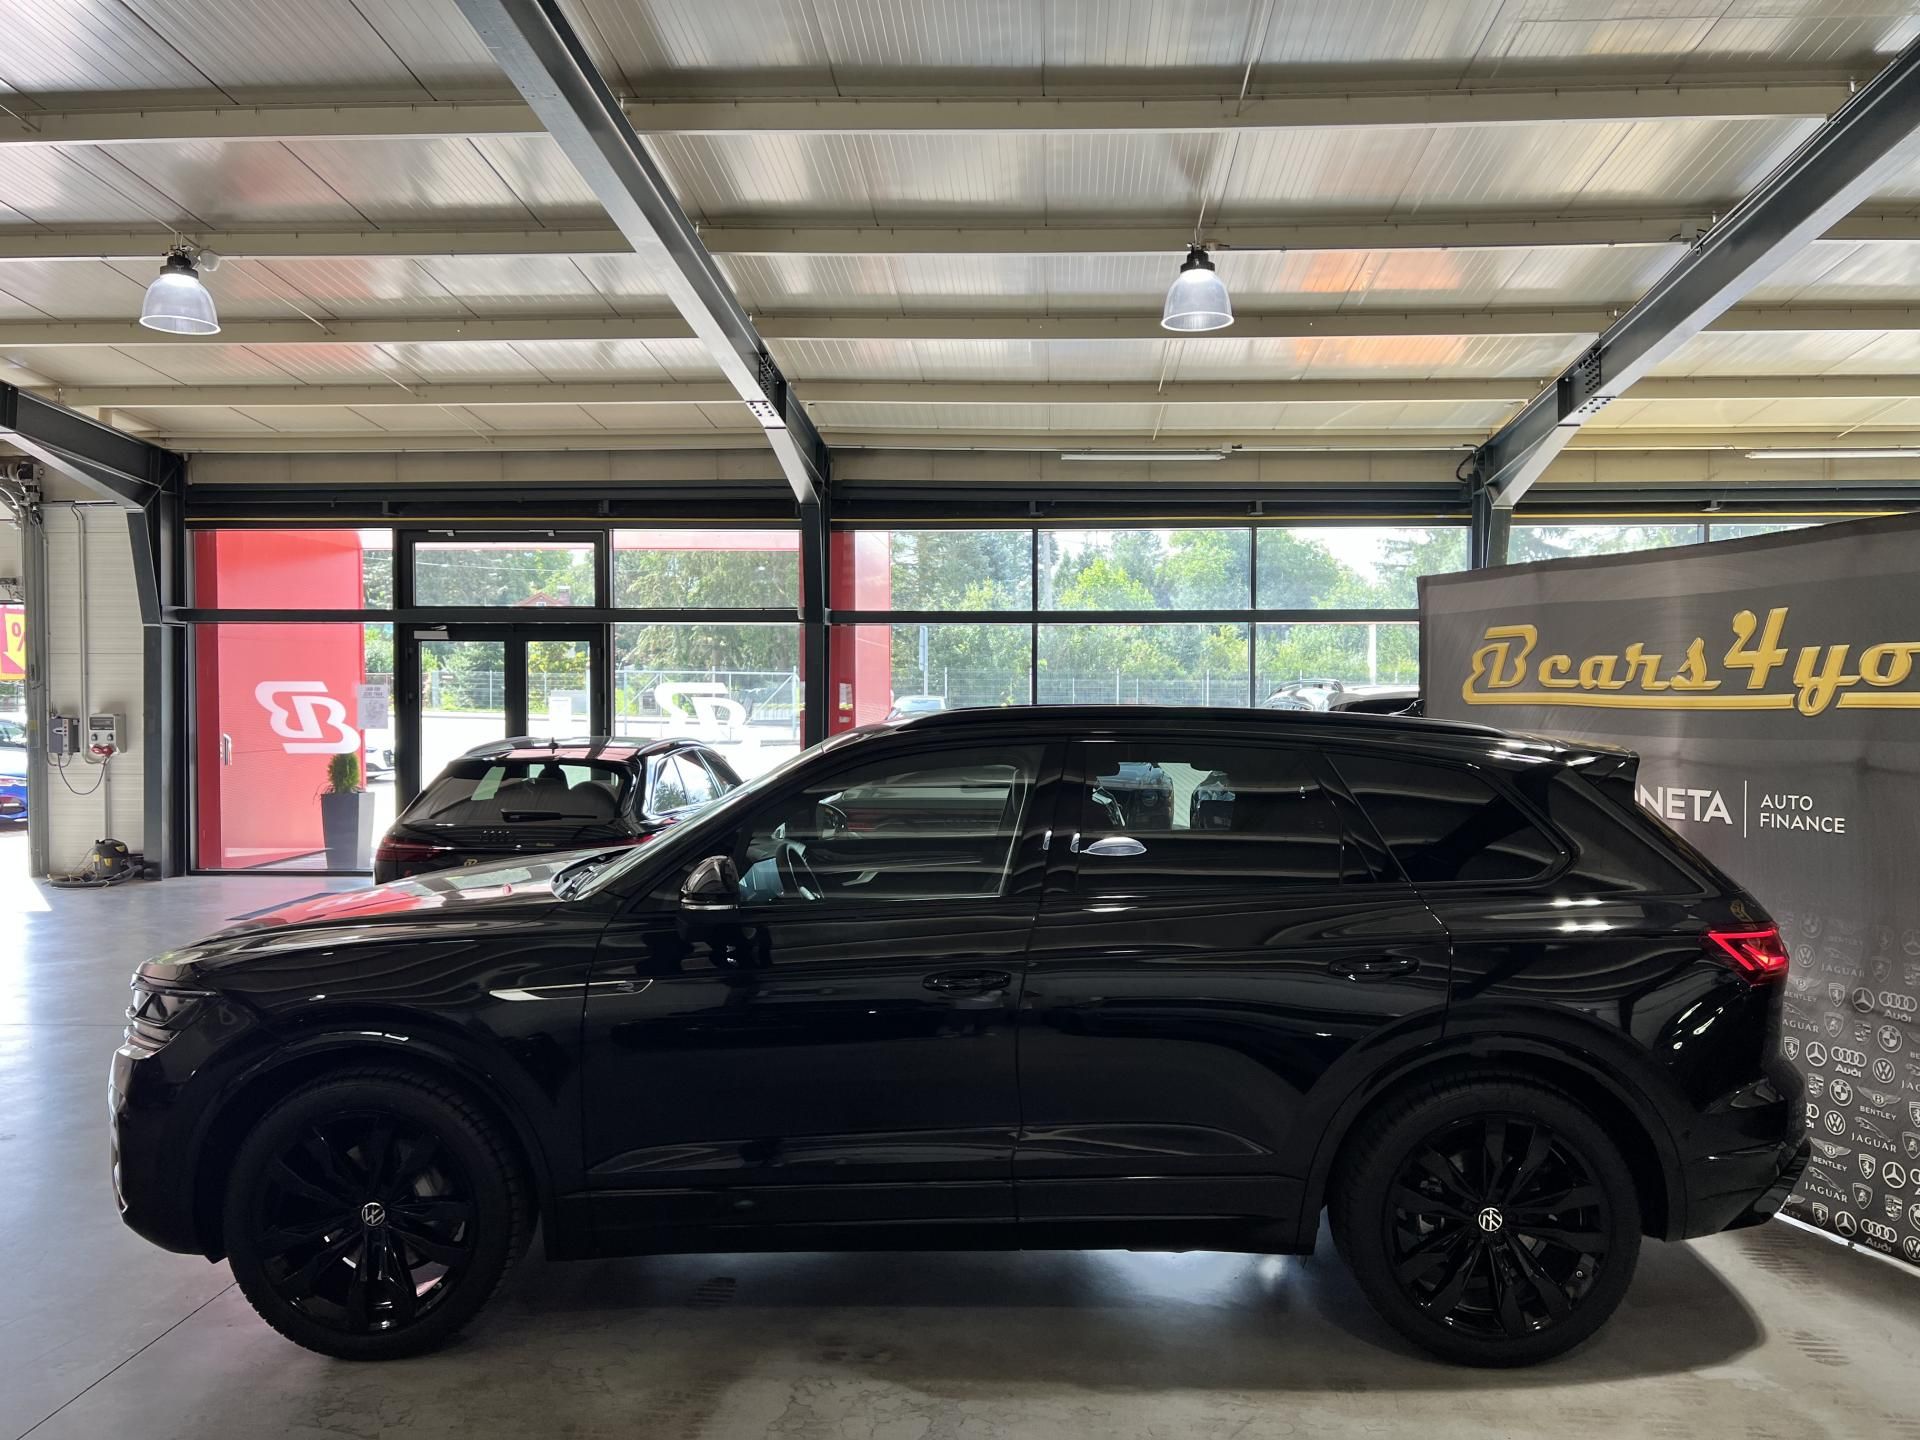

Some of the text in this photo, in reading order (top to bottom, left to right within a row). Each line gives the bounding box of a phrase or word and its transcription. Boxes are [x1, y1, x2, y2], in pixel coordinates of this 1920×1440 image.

[1635, 784, 1813, 825] NETA AUTO
[1760, 812, 1846, 834] FINANCE
[1884, 1009, 1912, 1023] Audi
[1783, 1019, 1819, 1033] AGUAR
[1835, 1064, 1862, 1078] Audi
[1860, 1105, 1897, 1121] BENTLEY
[1851, 1132, 1897, 1153] JAGUAR
[1813, 1156, 1848, 1172] BENTLEY
[1805, 1181, 1848, 1203] JAGUAR
[1865, 1237, 1892, 1253] Audi
